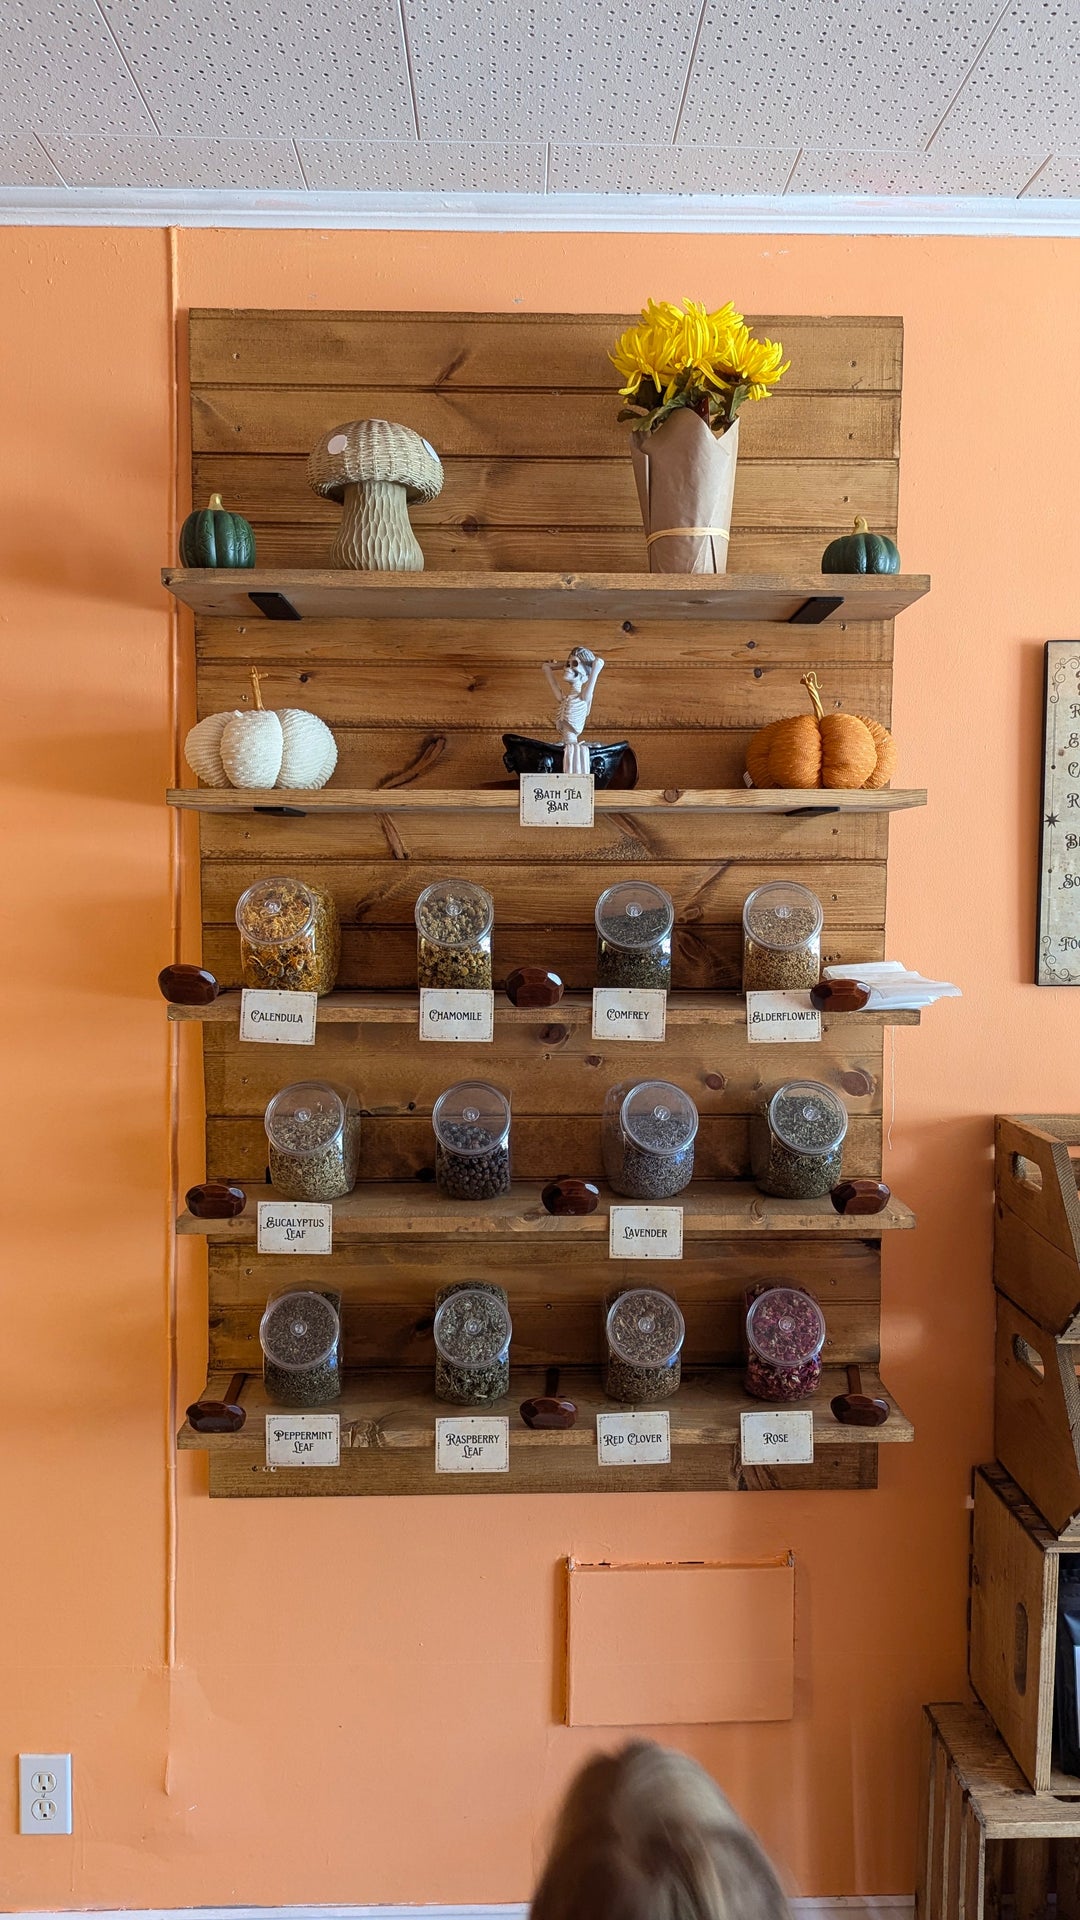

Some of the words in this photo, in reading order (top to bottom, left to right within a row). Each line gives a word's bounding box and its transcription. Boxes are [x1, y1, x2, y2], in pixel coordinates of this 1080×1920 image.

[533, 787, 561, 801] BATH
[564, 787, 583, 800] TEA
[547, 800, 569, 814] BAR
[250, 1009, 303, 1023] CALENDULA
[429, 1008, 482, 1022] CHAMOMILE
[606, 1008, 650, 1022] COMFREY
[750, 1010, 817, 1024] ELDERFLOWER
[263, 1216, 325, 1230] EUCALYPTUS
[284, 1228, 306, 1241] LEAF
[623, 1225, 668, 1240] LAVENDER
[274, 1429, 333, 1443] PEPPERMINT
[446, 1432, 499, 1447] RASPBERRY
[603, 1433, 624, 1447] RED
[626, 1431, 663, 1445] CLOVER
[763, 1432, 789, 1445] ROSE
[292, 1440, 314, 1453] LEAF
[462, 1444, 484, 1458] LEAF
